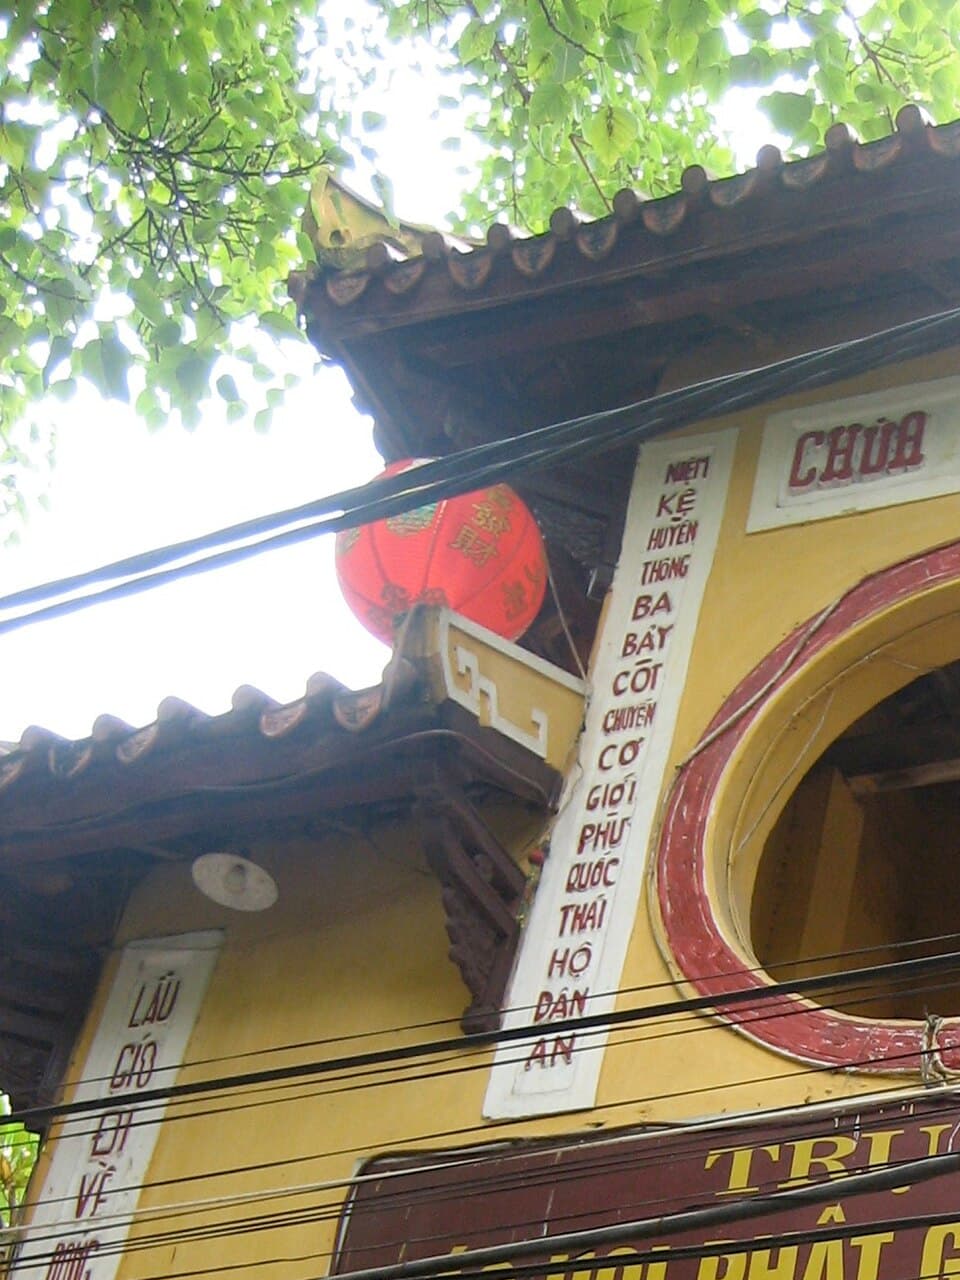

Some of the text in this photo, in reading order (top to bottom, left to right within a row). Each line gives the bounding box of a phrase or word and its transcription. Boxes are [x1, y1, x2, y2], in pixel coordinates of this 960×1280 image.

[788, 411, 927, 487] CHÙA
[632, 592, 671, 621] BA
[599, 738, 645, 770] CƠ
[549, 942, 592, 978] HỘ
[525, 1033, 575, 1071] AN
